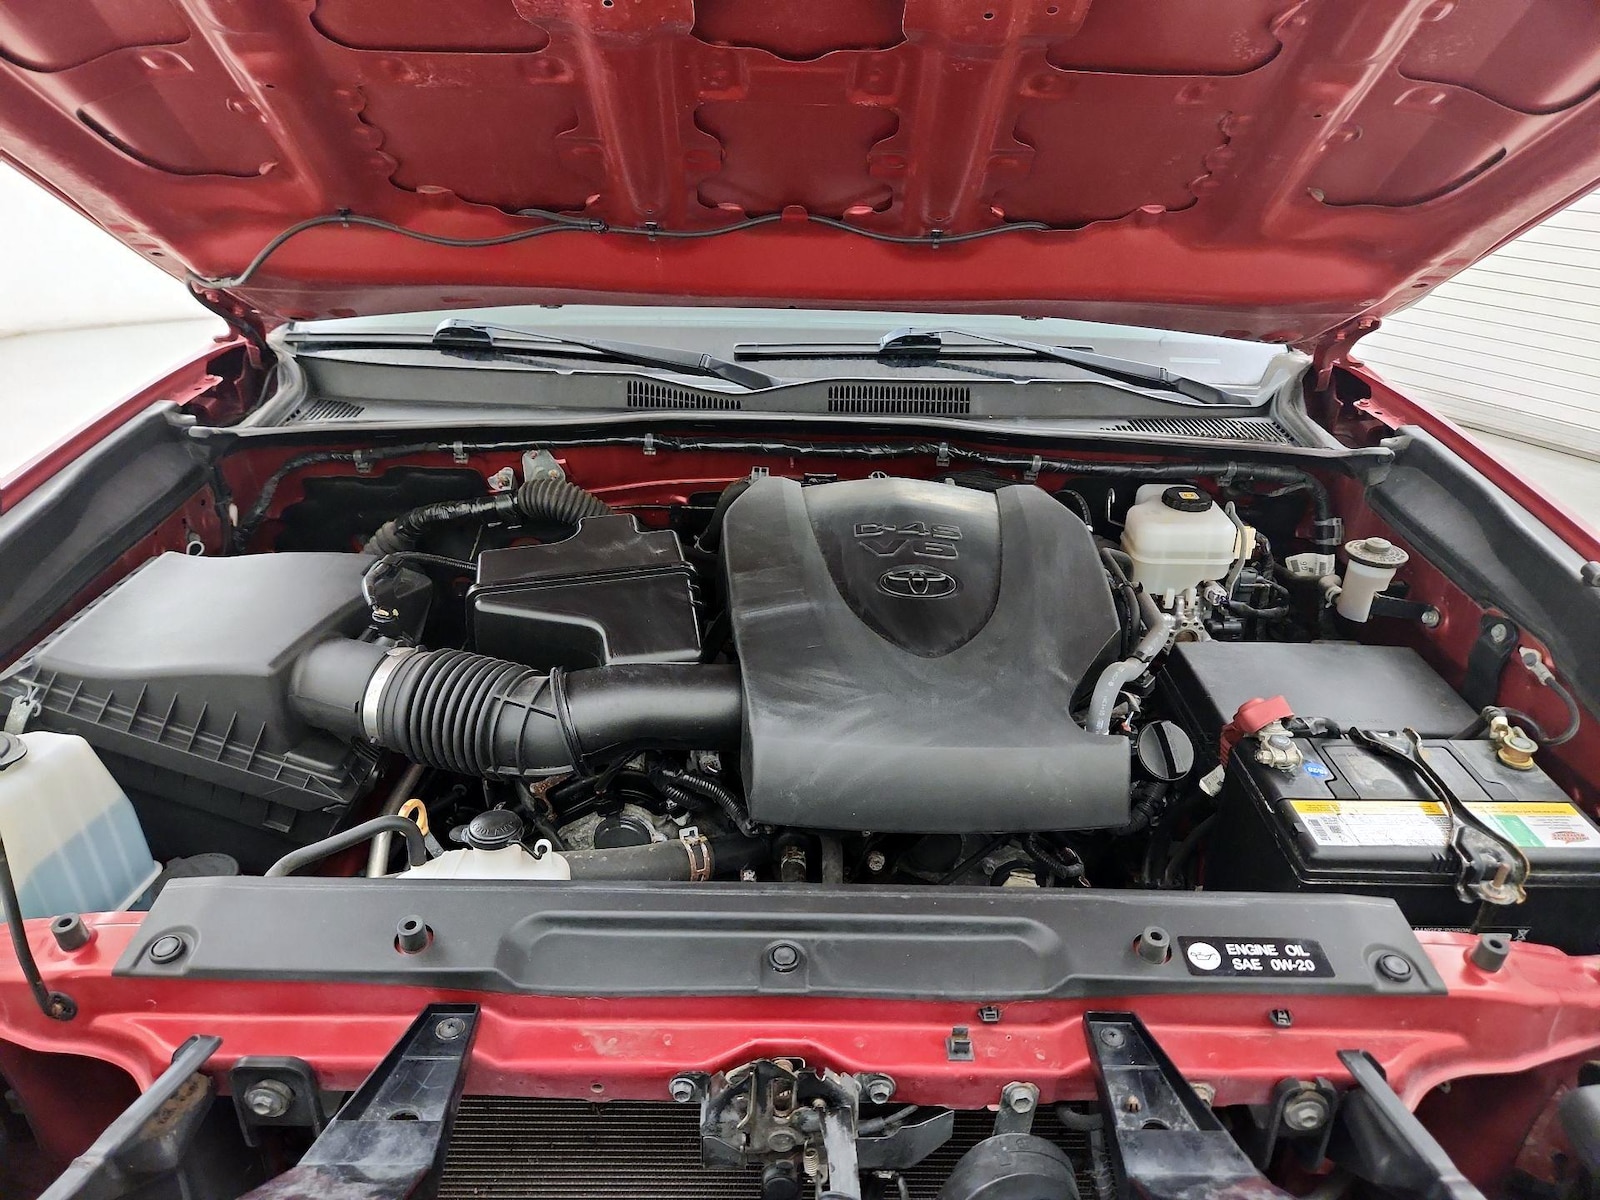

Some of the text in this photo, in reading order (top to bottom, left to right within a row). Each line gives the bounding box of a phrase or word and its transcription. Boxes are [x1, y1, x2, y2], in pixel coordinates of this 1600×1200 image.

[859, 538, 958, 560] V6
[1225, 943, 1311, 957] ENGINE OIL
[1232, 958, 1316, 972] SAE 0W-20
